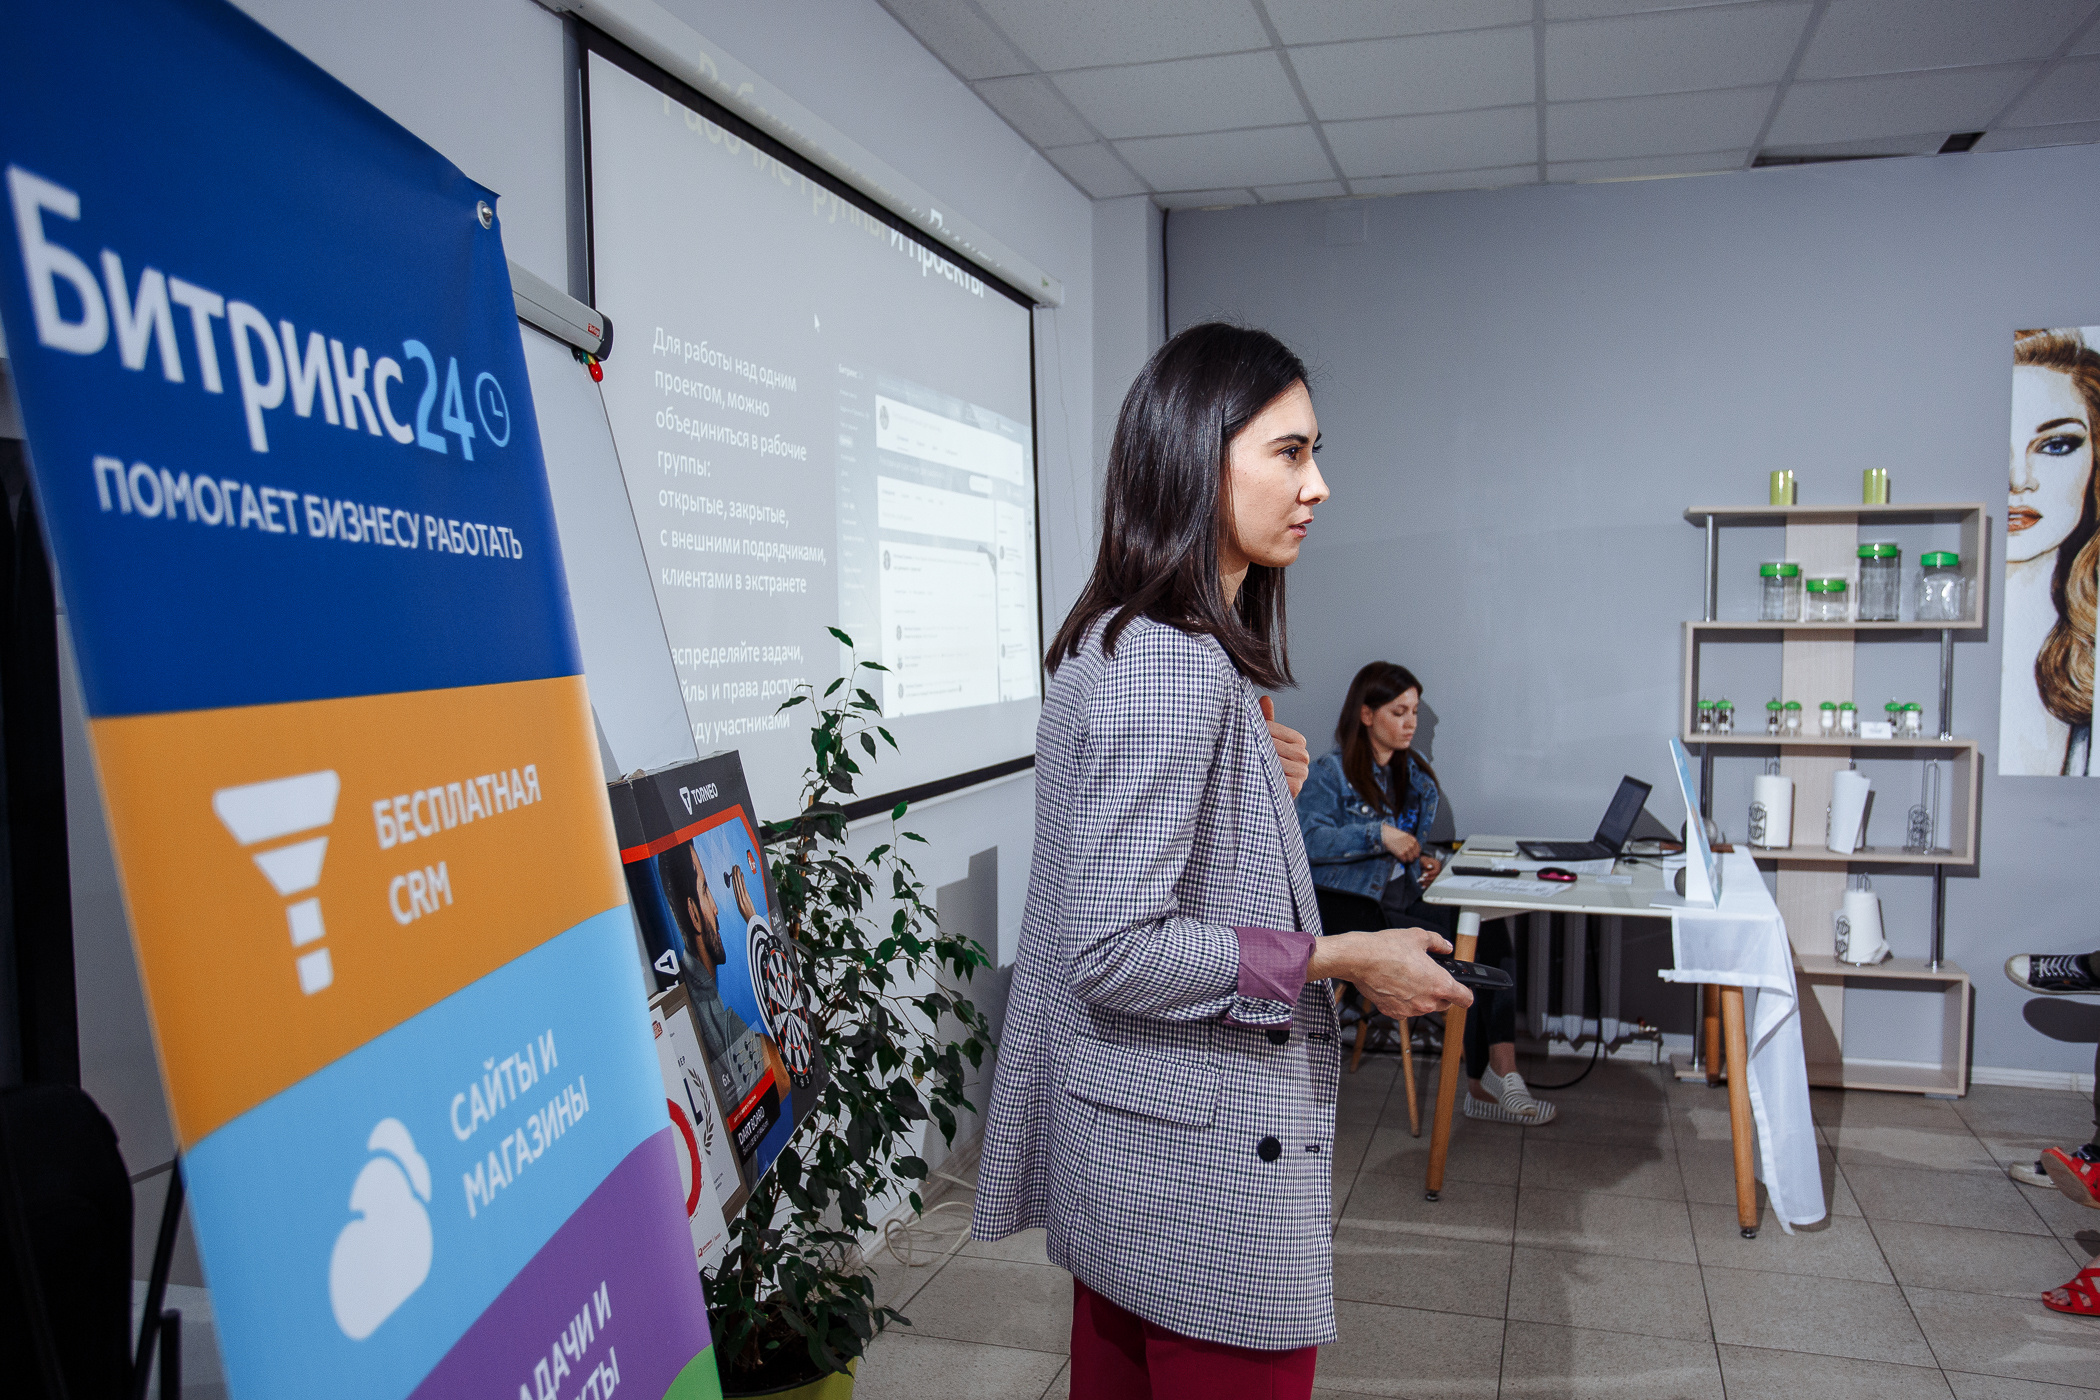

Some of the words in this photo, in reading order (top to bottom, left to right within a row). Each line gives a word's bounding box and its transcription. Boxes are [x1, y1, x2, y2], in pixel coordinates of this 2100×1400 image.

[6, 163, 475, 461] Битрикс24
[653, 326, 681, 357] Для
[684, 341, 732, 372] работы
[735, 358, 758, 384] над
[759, 367, 797, 392] одним
[655, 370, 726, 409] проектом,
[727, 391, 770, 417] можно
[655, 406, 749, 448] объединиться
[751, 434, 758, 450] в
[760, 434, 807, 461] рабочие
[657, 450, 711, 477] группы:
[93, 455, 299, 534] ПОМОГАЕТ
[304, 495, 420, 549] БИЗНЕСУ
[425, 516, 523, 560] РАБОТАТЬ
[658, 489, 727, 521] открытые,
[729, 501, 789, 528] закрытые,
[660, 529, 668, 546] с
[671, 531, 740, 554] внешними
[742, 538, 827, 566] подрядчиками,
[662, 567, 732, 590] клиентами
[735, 574, 742, 590] в
[744, 574, 807, 597] экстранете
[671, 640, 760, 671] аспределяйте
[762, 644, 804, 666] задачи,
[681, 678, 708, 703] йлы
[712, 683, 720, 700] и
[723, 681, 759, 704] права
[761, 676, 806, 700] доступа
[713, 713, 790, 743] участниками
[372, 764, 541, 849] БЕСПЛАТНАЯ
[690, 782, 718, 806] TORNEO
[388, 861, 453, 925] CRM
[451, 1043, 539, 1142] САЙТЫ
[538, 1028, 559, 1075] И
[462, 1075, 590, 1219] МАГАЗИНЫ
[519, 1302, 595, 1400] ДАЧИ
[593, 1280, 612, 1330] И
